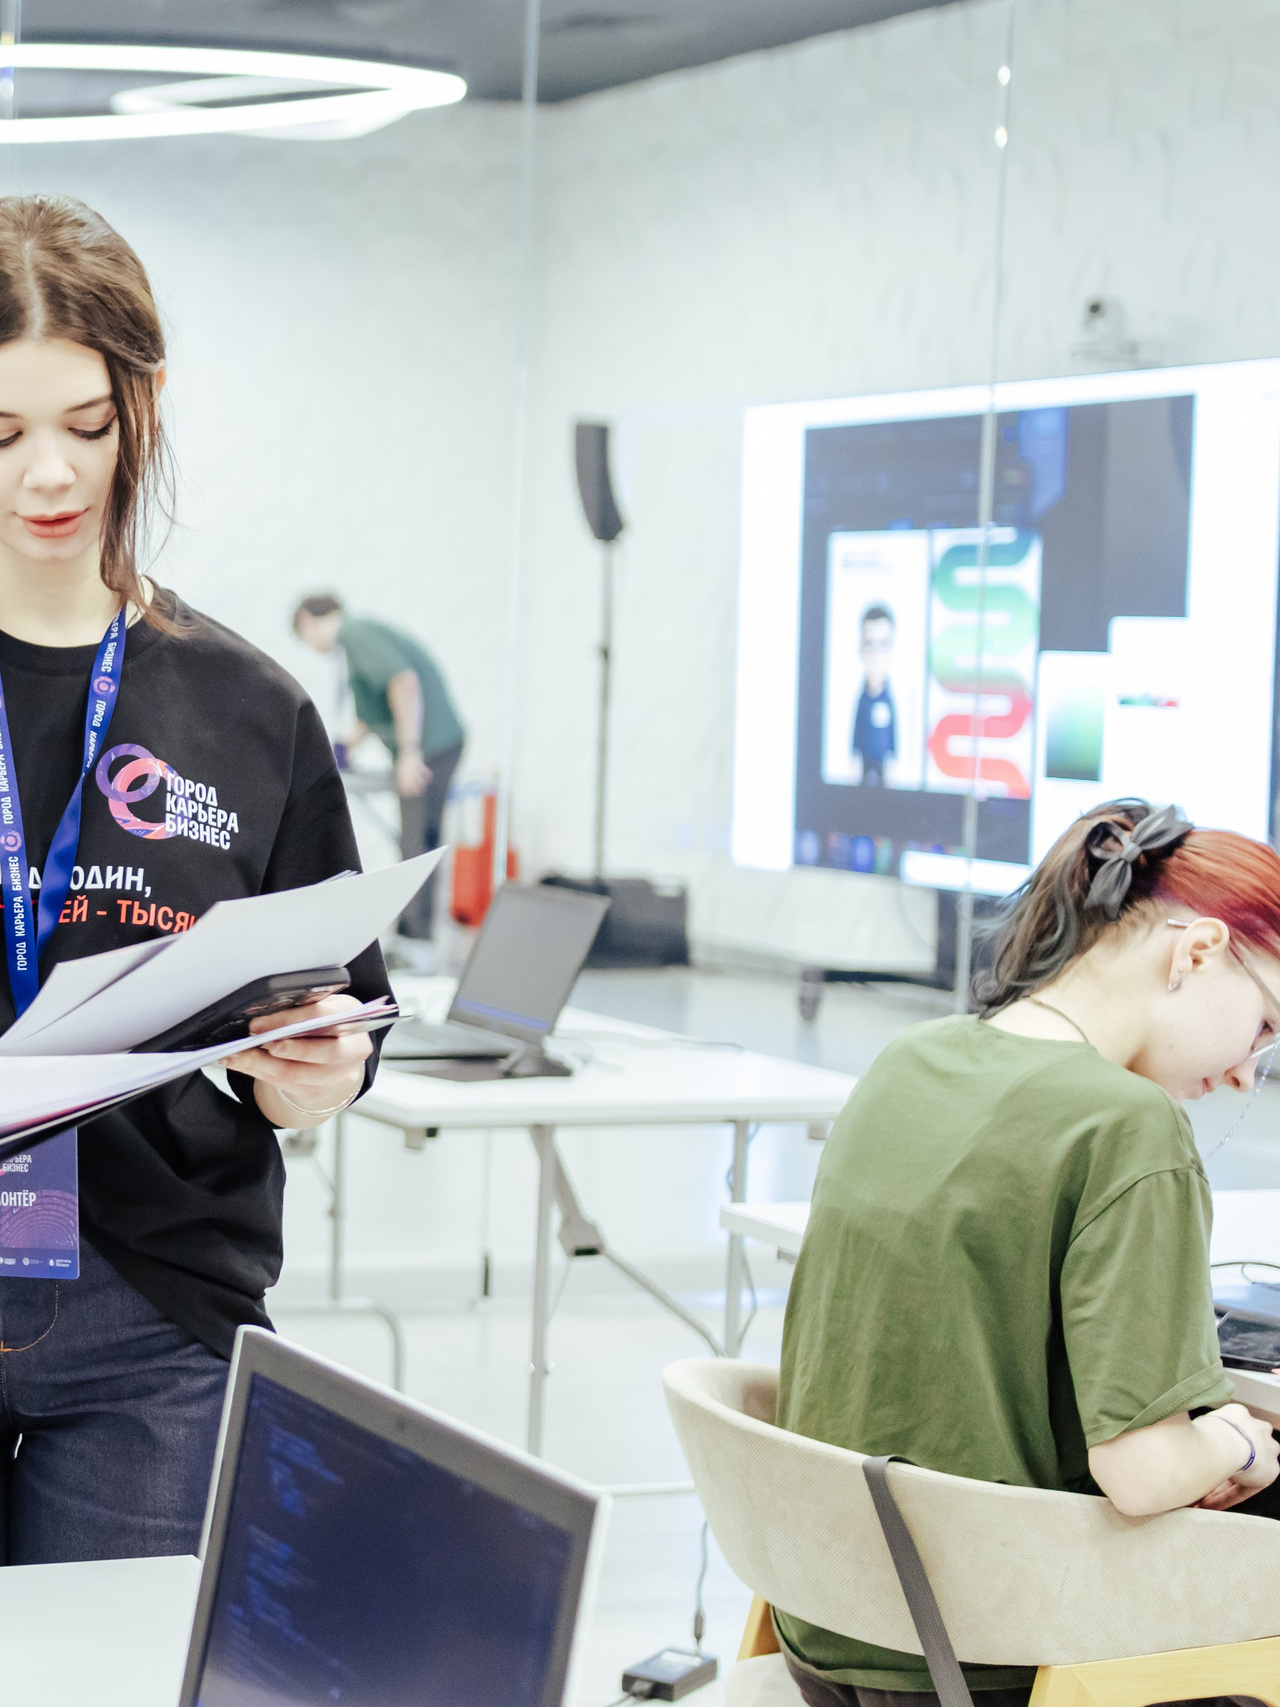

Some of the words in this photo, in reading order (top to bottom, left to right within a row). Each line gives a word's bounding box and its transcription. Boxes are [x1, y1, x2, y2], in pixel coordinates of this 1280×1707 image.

[101, 642, 117, 673] БИЗНЕС
[92, 699, 106, 728] ГОРОД
[86, 730, 98, 768] КАРЬЕРА
[166, 772, 218, 807] ГОРОД
[1, 796, 14, 825] ГОРОД
[165, 792, 239, 834] КАРЬЕРА
[165, 812, 231, 850] БИЗНЕС
[8, 856, 23, 891] БИЗНЕС
[70, 865, 152, 898] ОДИН,
[13, 896, 26, 937] КАРЬЕРА
[16, 941, 28, 971] ГОРОД
[2, 1163, 29, 1172] БИЗНЕС
